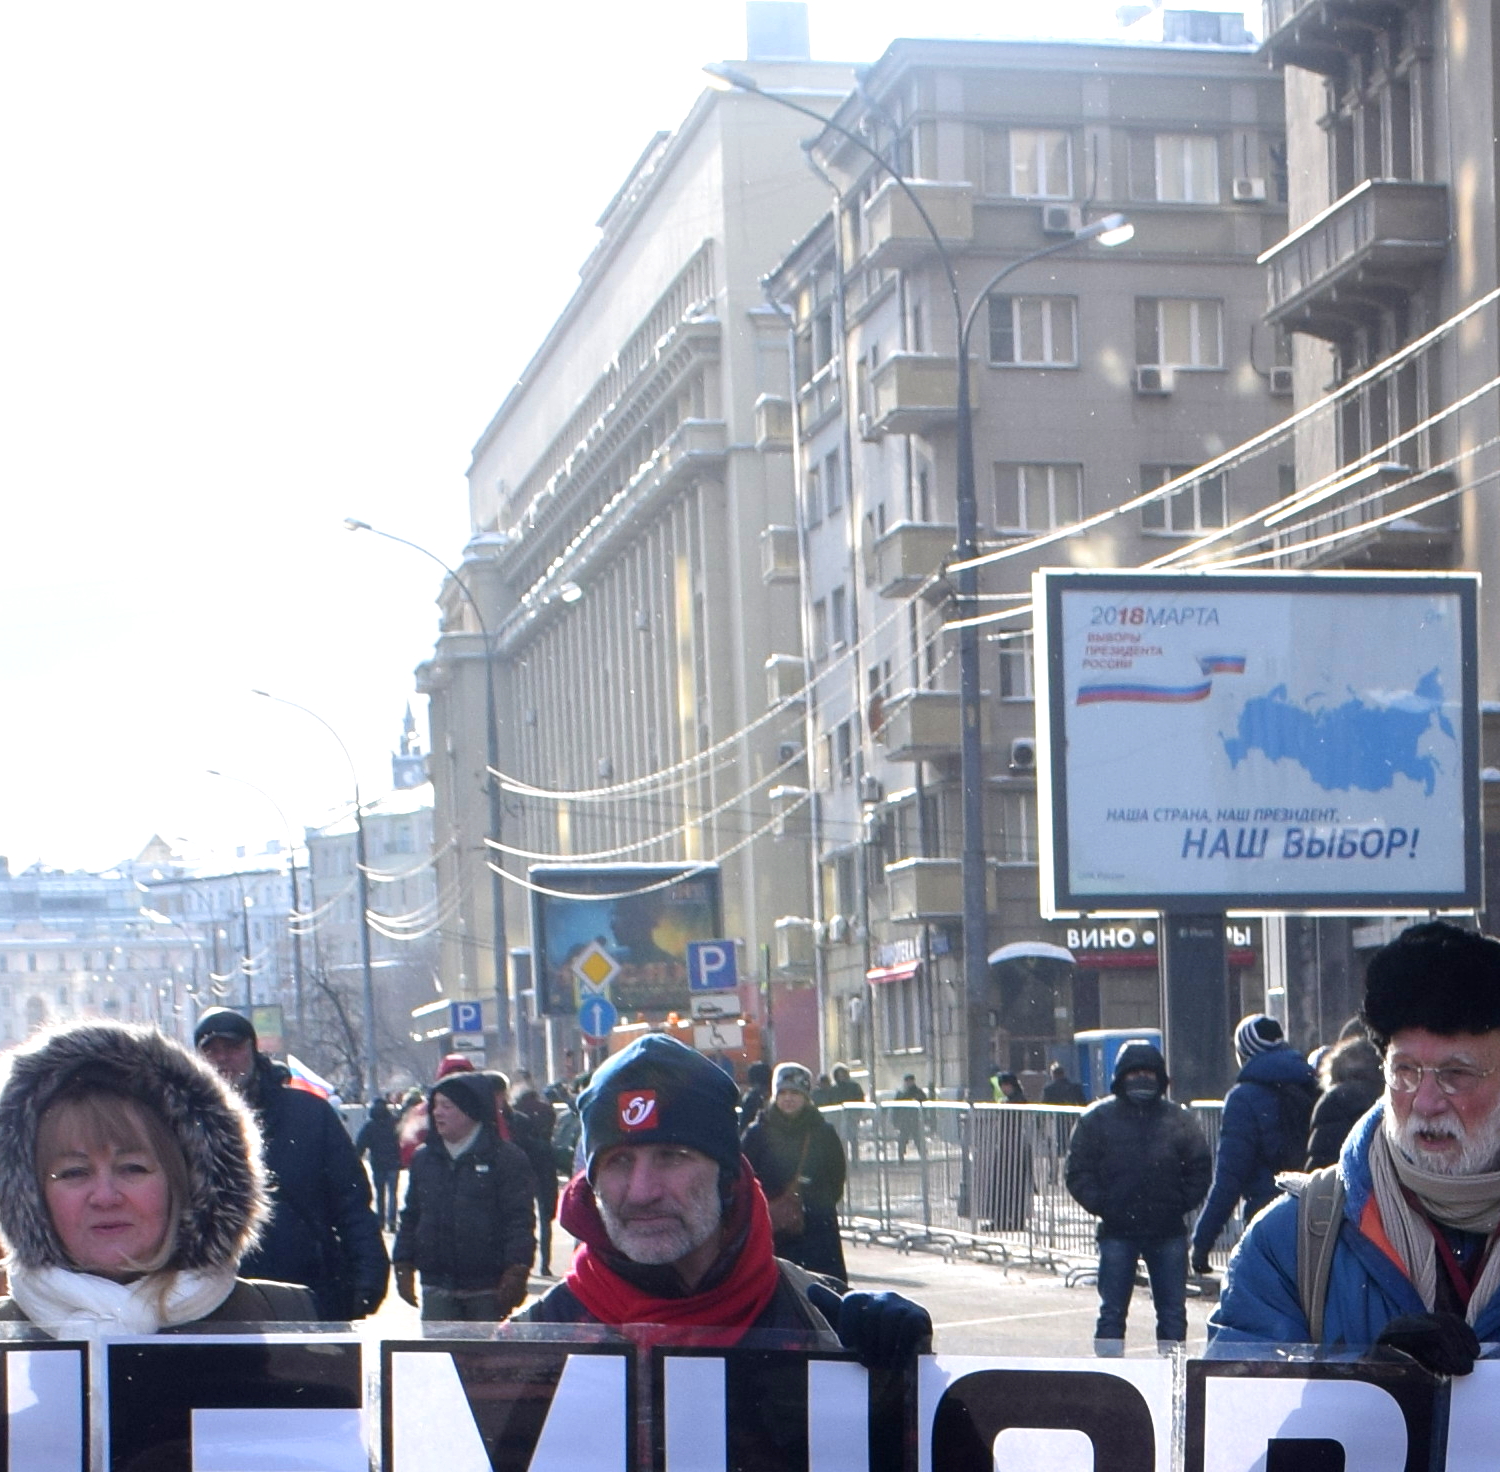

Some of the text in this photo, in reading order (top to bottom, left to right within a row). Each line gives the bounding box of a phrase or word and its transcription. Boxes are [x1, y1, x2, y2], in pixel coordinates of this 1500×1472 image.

[1087, 631, 1141, 643] ВЫБОРЫ
[1085, 645, 1163, 657] ПРЕЗИДЕНТА
[1082, 658, 1133, 669] РОССИИ
[1106, 807, 1149, 822] НАША
[1153, 807, 1212, 825] СТРАНА,
[1216, 808, 1250, 822] НАШ
[1181, 827, 1420, 860] НАШ ВЫБОР!
[1067, 929, 1135, 949] ВИНО
[698, 945, 726, 986] P
[458, 1004, 477, 1029] P
